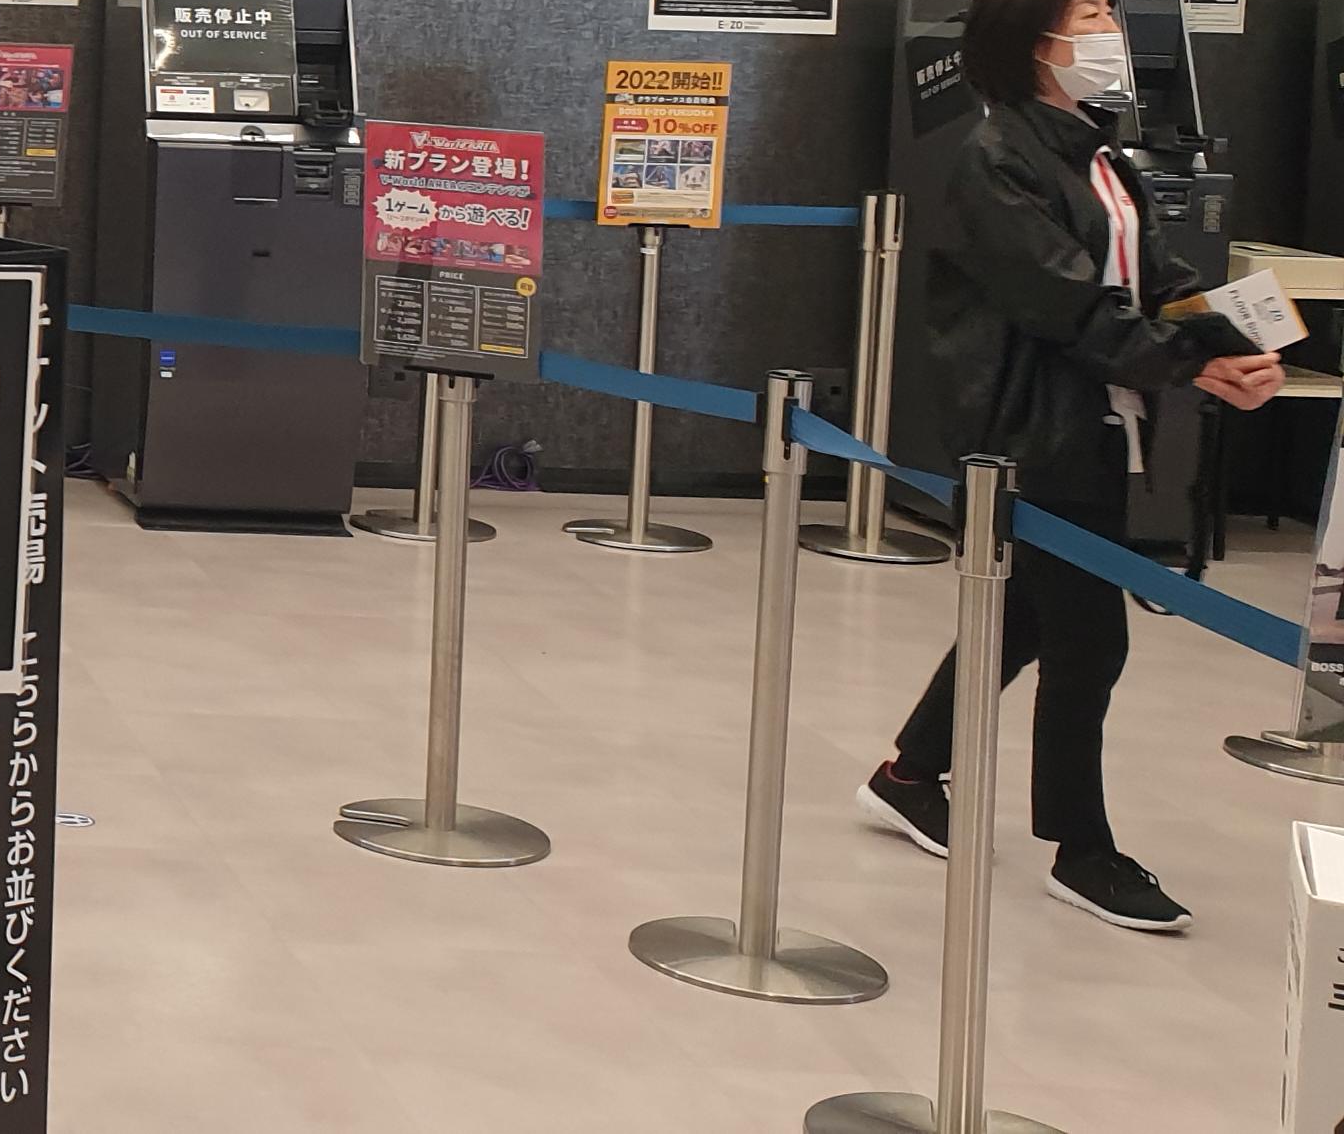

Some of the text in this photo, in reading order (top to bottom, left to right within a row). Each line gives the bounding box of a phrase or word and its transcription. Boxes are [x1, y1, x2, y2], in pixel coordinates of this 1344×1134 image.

[175, 7, 271, 26] 販売停止中
[181, 30, 267, 39] OUT OF SERVICE
